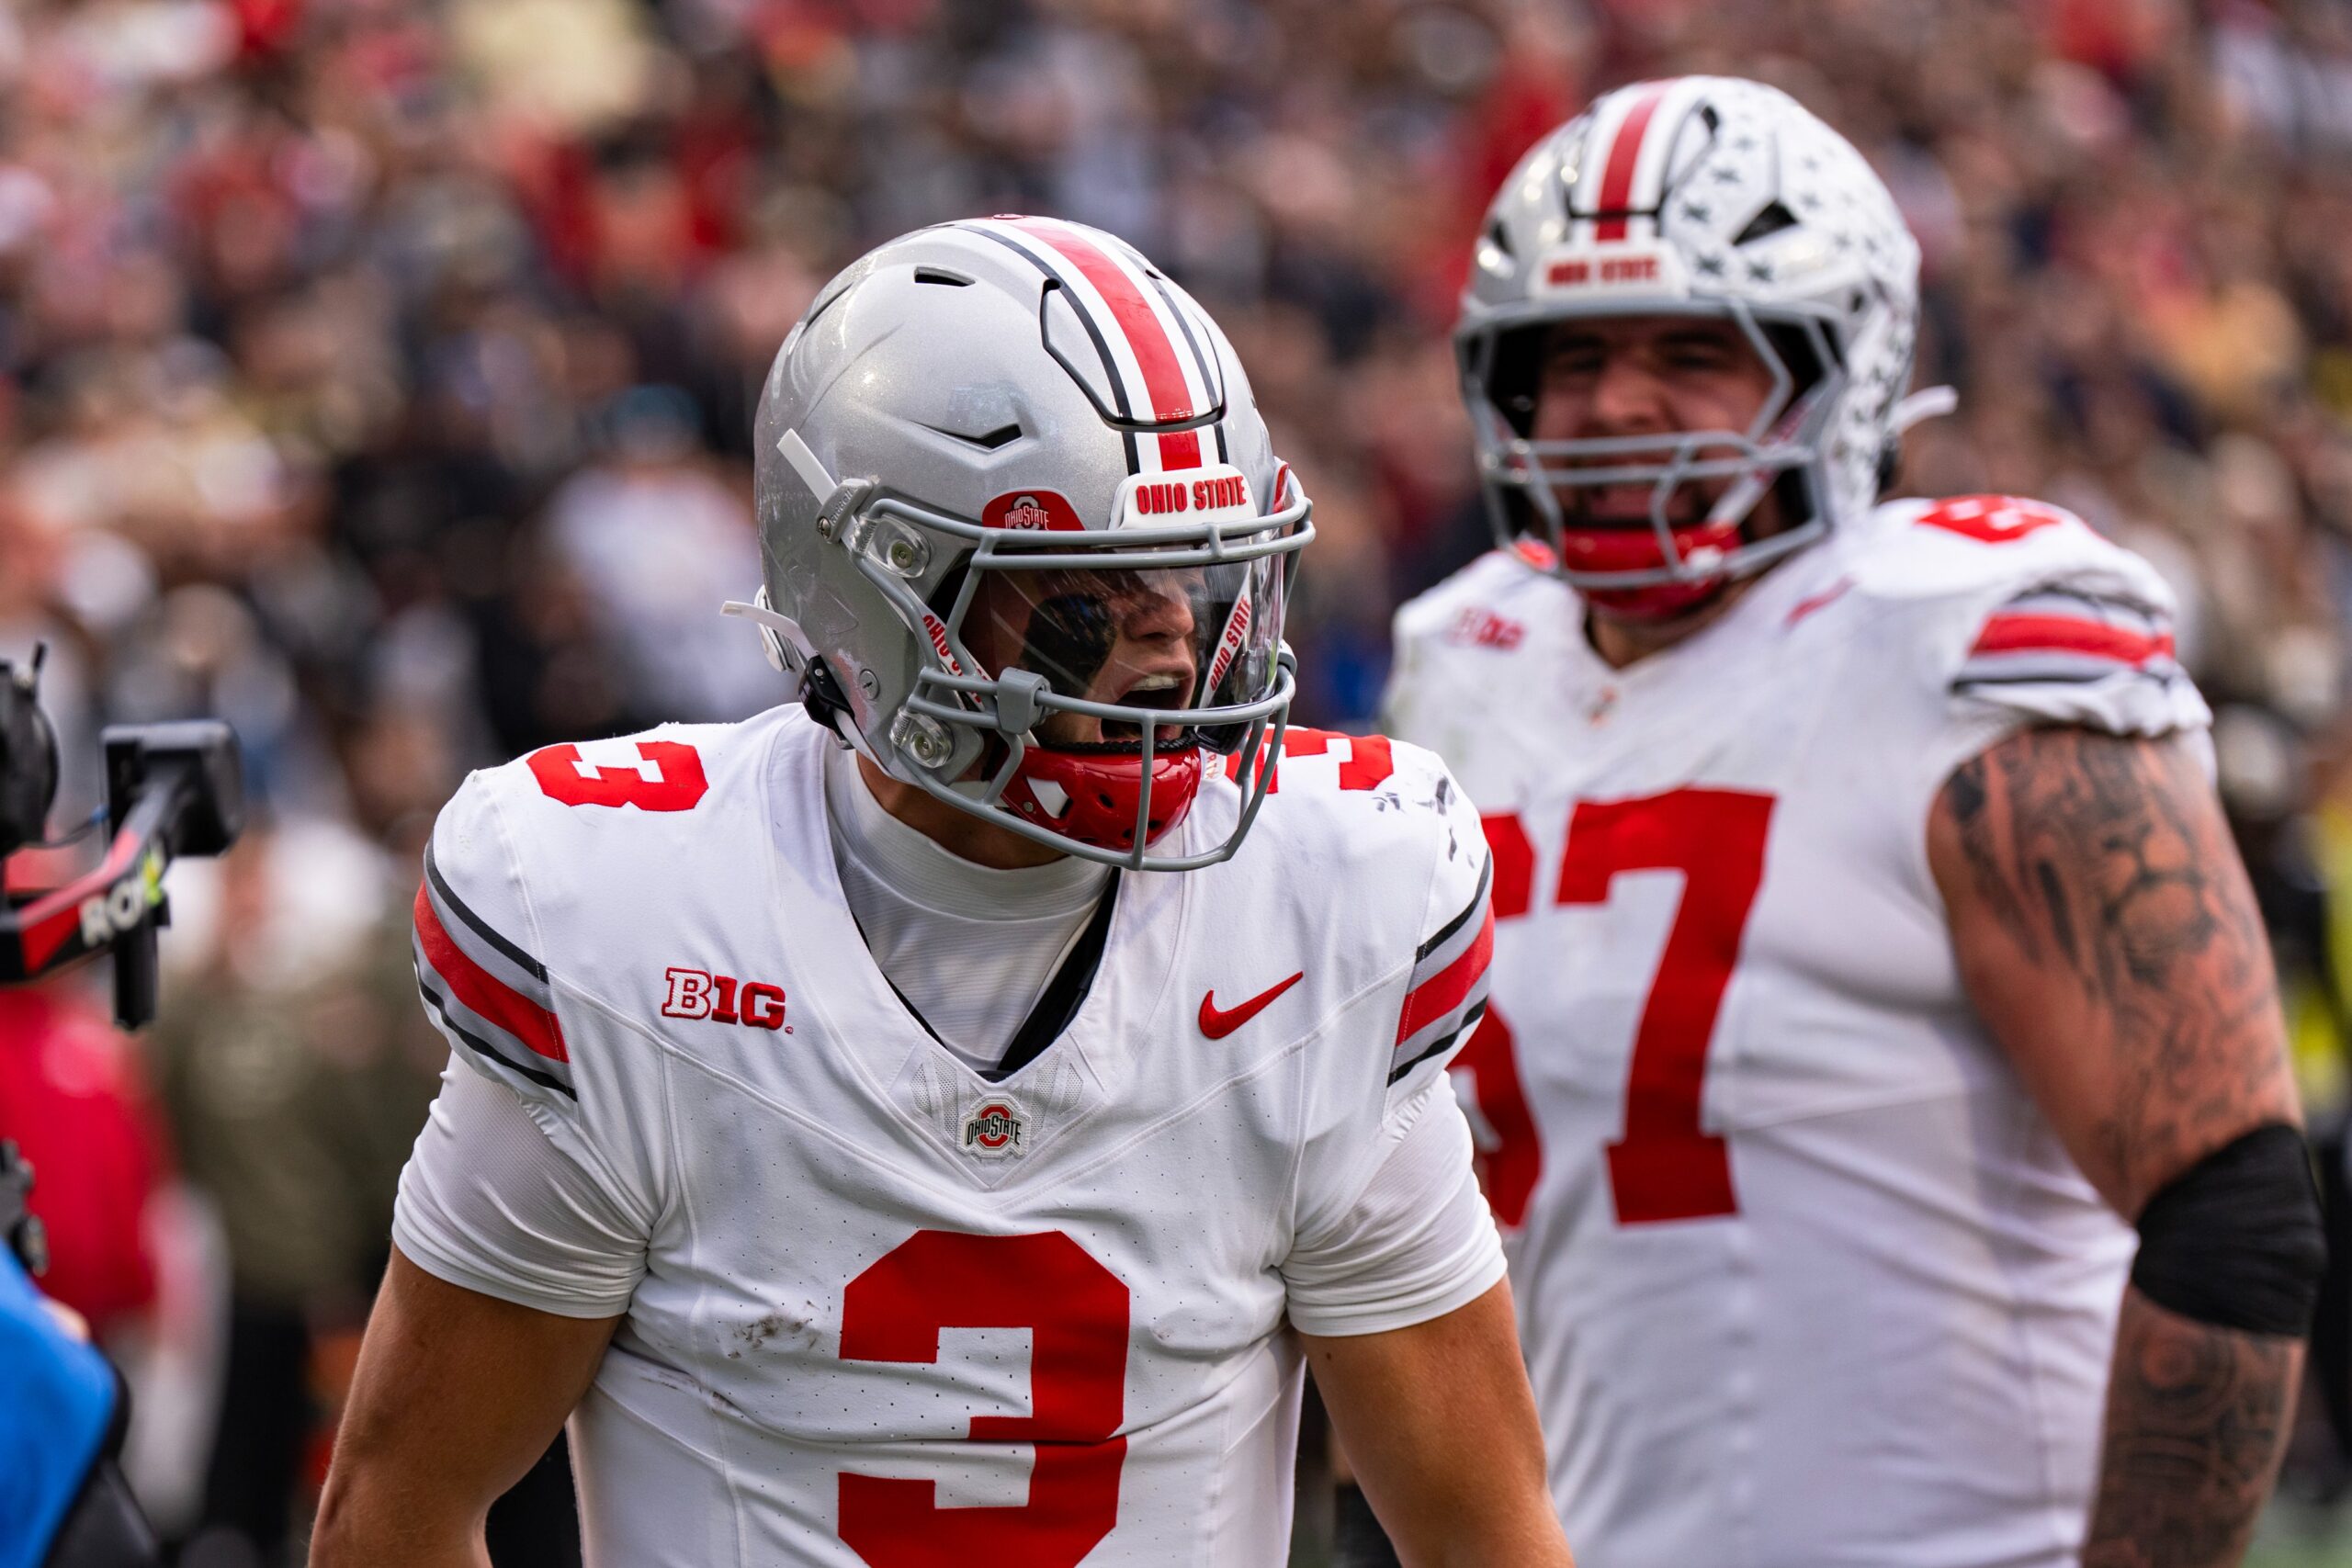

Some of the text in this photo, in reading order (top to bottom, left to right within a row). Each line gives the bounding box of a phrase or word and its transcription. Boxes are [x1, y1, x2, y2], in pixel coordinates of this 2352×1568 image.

[1136, 476, 1247, 514] OHIO STATE
[1210, 646, 1232, 692] OHIO
[525, 740, 710, 812] 3
[838, 1229, 1131, 1567] 3
